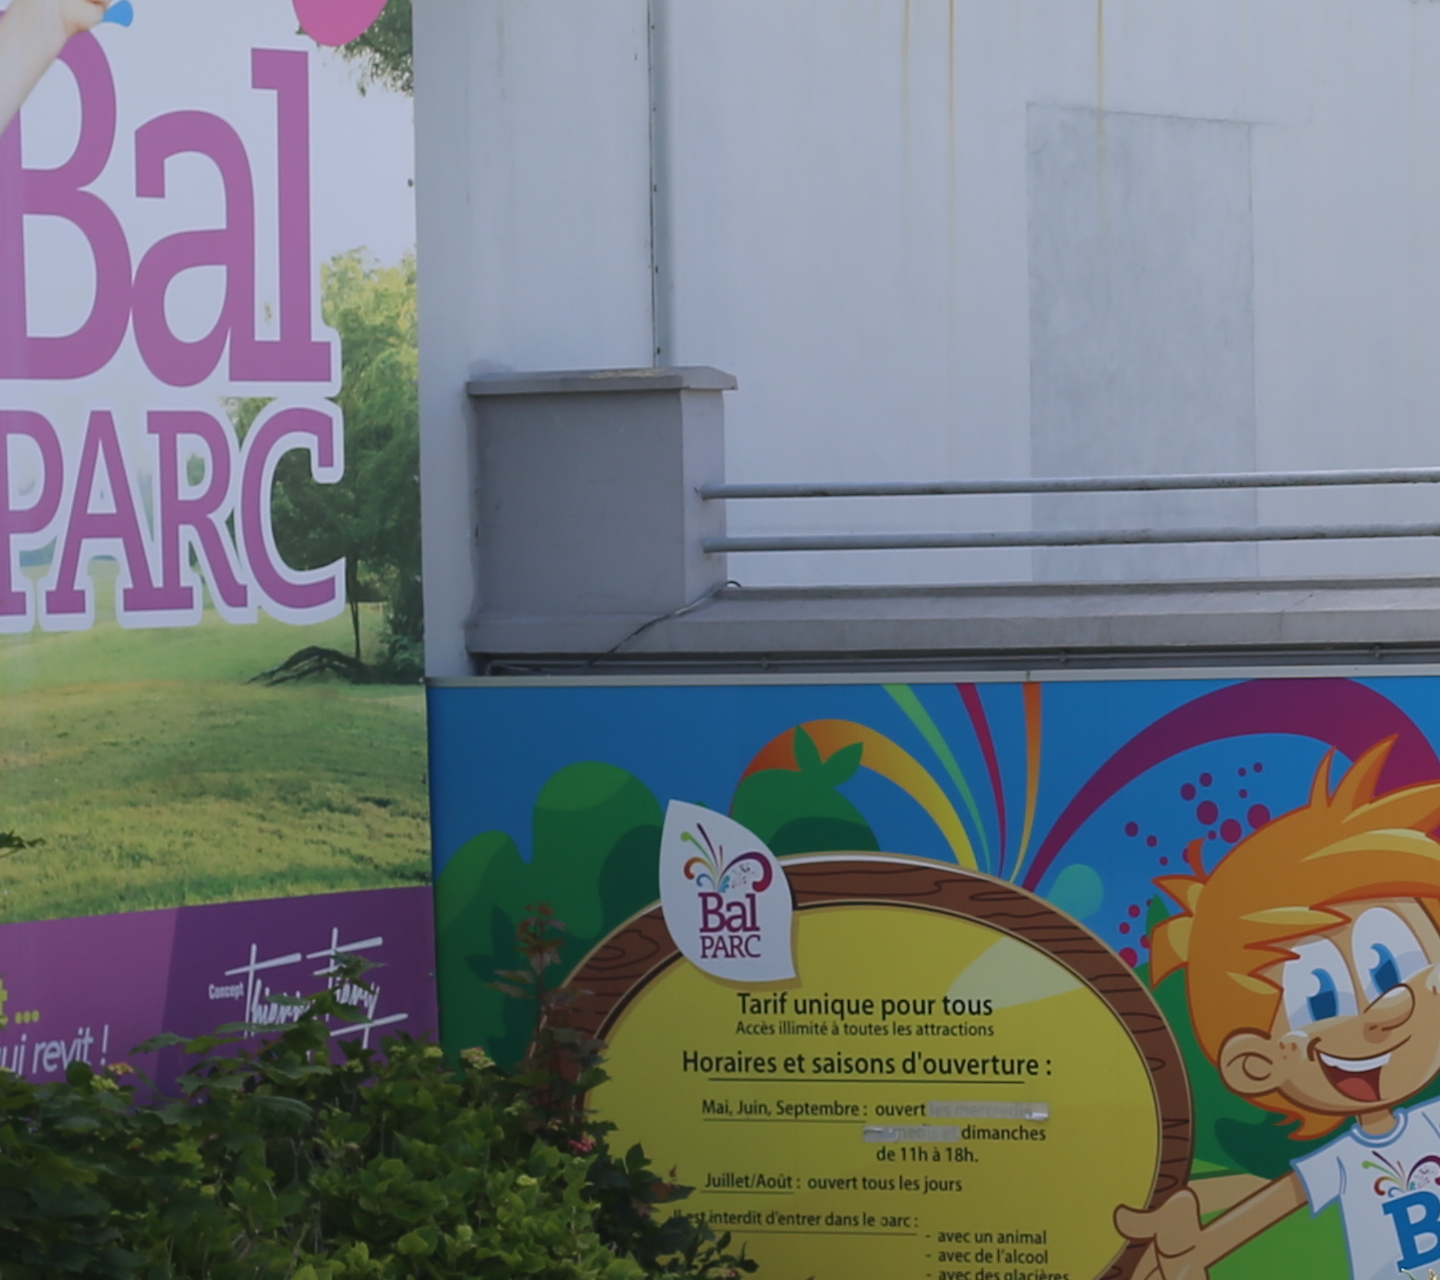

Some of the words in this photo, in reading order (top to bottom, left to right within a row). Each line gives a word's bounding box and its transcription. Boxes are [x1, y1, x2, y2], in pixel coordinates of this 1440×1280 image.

[698, 892, 761, 933] Bal
[699, 934, 762, 959] PARC
[737, 992, 788, 1015] Tarif
[793, 994, 874, 1020] unique
[881, 997, 936, 1020] pour
[942, 996, 993, 1016] tous
[735, 1021, 775, 1036] Accès
[778, 1021, 828, 1036] illimité
[831, 1022, 840, 1036] à
[843, 1022, 888, 1037] toutes
[892, 1022, 912, 1037] les
[916, 1022, 995, 1037] attractions
[32, 1026, 94, 1075] revit
[682, 1050, 777, 1073] Horaires
[783, 1053, 806, 1074] et
[812, 1052, 896, 1075] saisons
[901, 1052, 1040, 1076] d'ouverture
[702, 1100, 733, 1116] Mai,
[737, 1100, 773, 1117] Juin,
[776, 1100, 859, 1119] Septembre
[875, 1104, 926, 1117] ouvert
[961, 1125, 1046, 1141] dimanches
[876, 1147, 896, 1161] de
[901, 1146, 928, 1162] 11h
[932, 1147, 941, 1162] à
[946, 1147, 978, 1162] 18h.
[704, 1173, 793, 1189] Juillet/Août
[807, 1178, 858, 1190] ouvert
[862, 1177, 895, 1191] tous
[899, 1176, 920, 1191] les
[923, 1177, 962, 1193] jours
[710, 1210, 762, 1225] interdit
[765, 1211, 821, 1226] d'entrer
[825, 1211, 859, 1226] dans
[862, 1212, 875, 1227] le
[938, 1232, 970, 1244] avec
[974, 1232, 993, 1244] un
[997, 1230, 1047, 1244] animal
[938, 1251, 971, 1263] avec
[975, 1248, 993, 1263] de
[997, 1248, 1048, 1264] l'alcool
